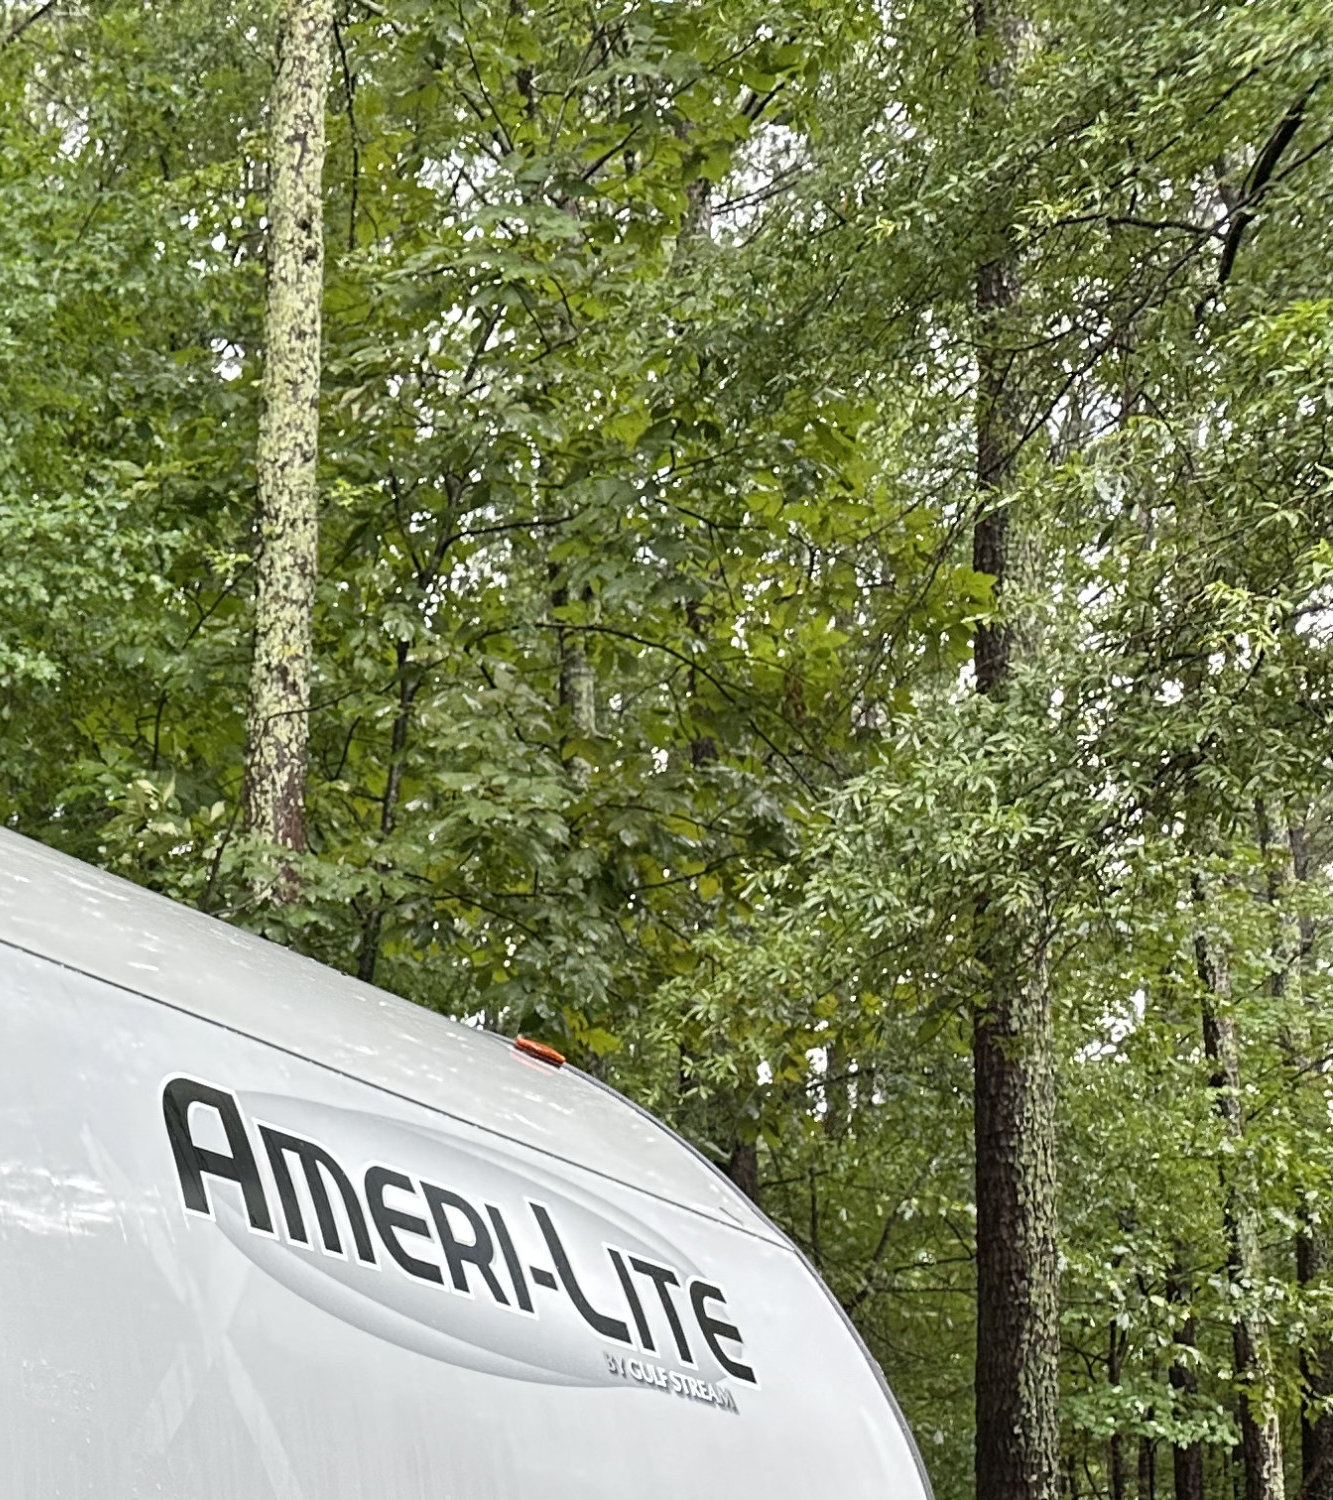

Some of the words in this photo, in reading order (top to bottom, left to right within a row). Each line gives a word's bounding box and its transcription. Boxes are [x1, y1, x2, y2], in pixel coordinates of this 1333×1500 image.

[160, 1071, 760, 1387] AMERI-LITE
[604, 1351, 627, 1379] BY
[628, 1358, 671, 1394] GULF
[669, 1370, 740, 1415] STREAM
